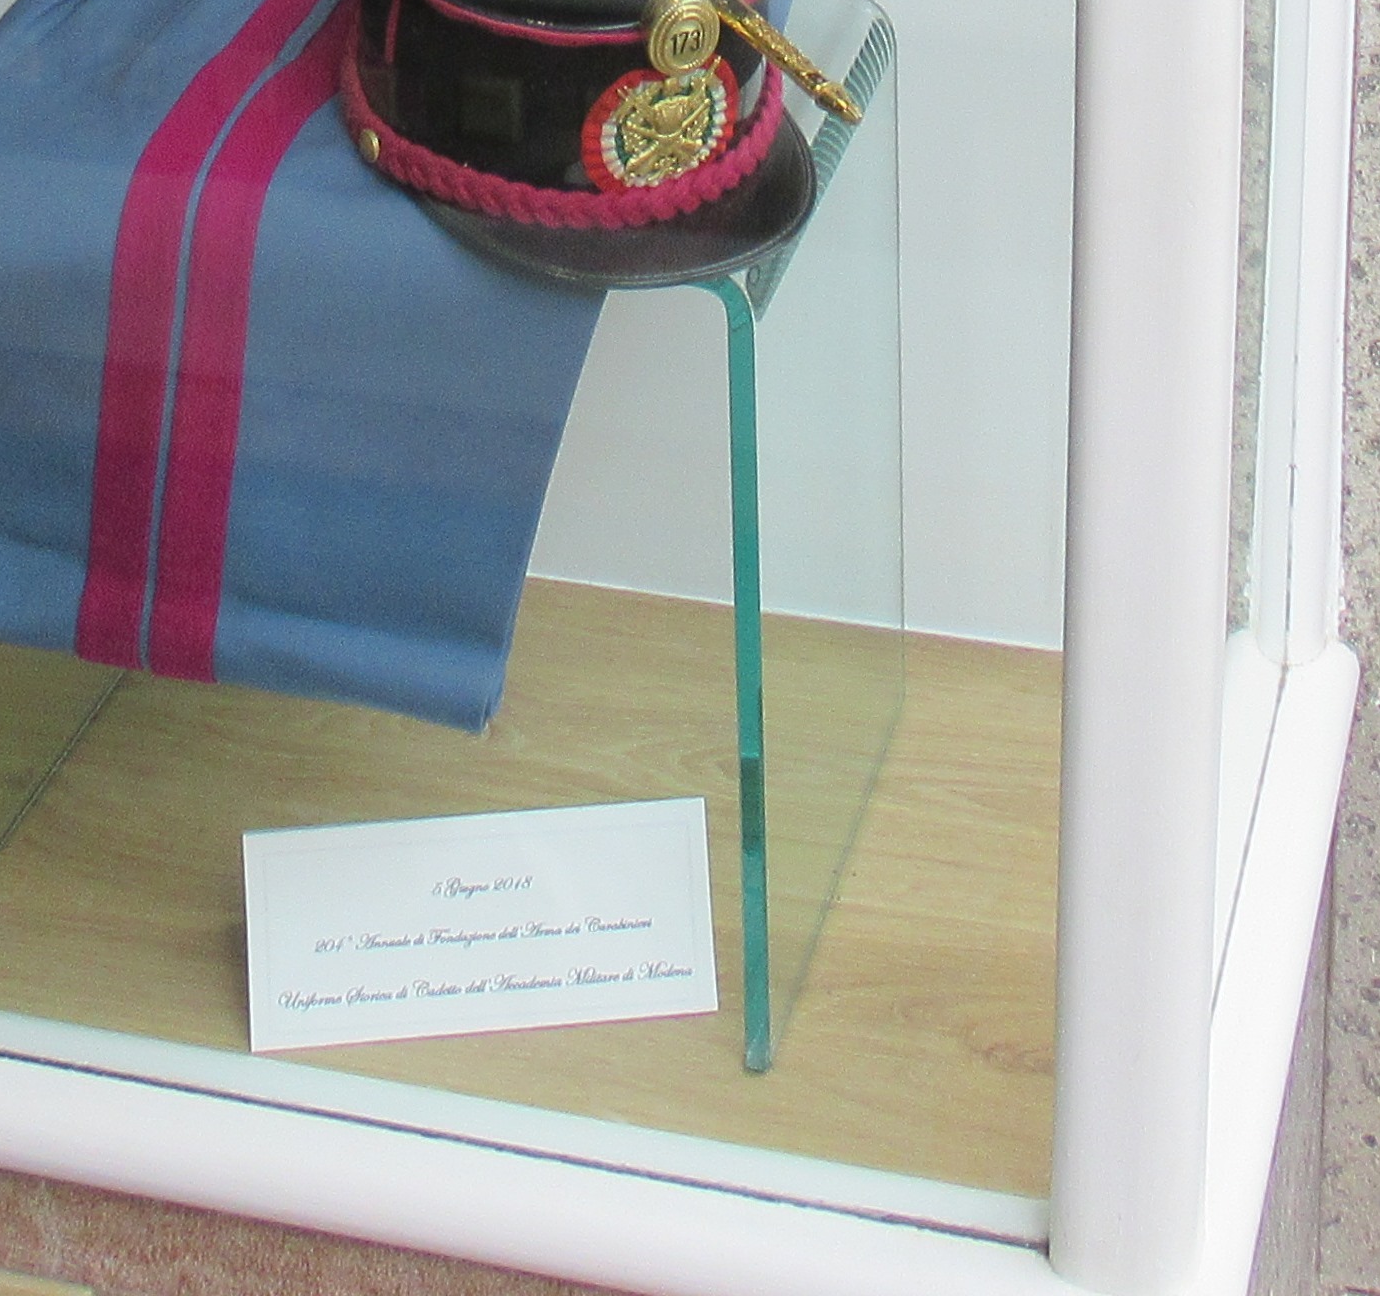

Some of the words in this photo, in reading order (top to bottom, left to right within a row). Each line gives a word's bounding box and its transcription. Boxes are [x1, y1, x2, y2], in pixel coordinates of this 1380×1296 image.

[671, 30, 701, 56] 173
[432, 882, 443, 895] 5
[492, 875, 533, 890] 2018
[413, 932, 425, 946] di
[426, 927, 496, 949] Fondazione
[564, 921, 581, 934] dei
[584, 916, 652, 932] Carabinieri
[395, 984, 408, 998] di
[412, 978, 462, 998] Cadetto
[622, 967, 634, 980] di
[639, 961, 693, 979] Modena
